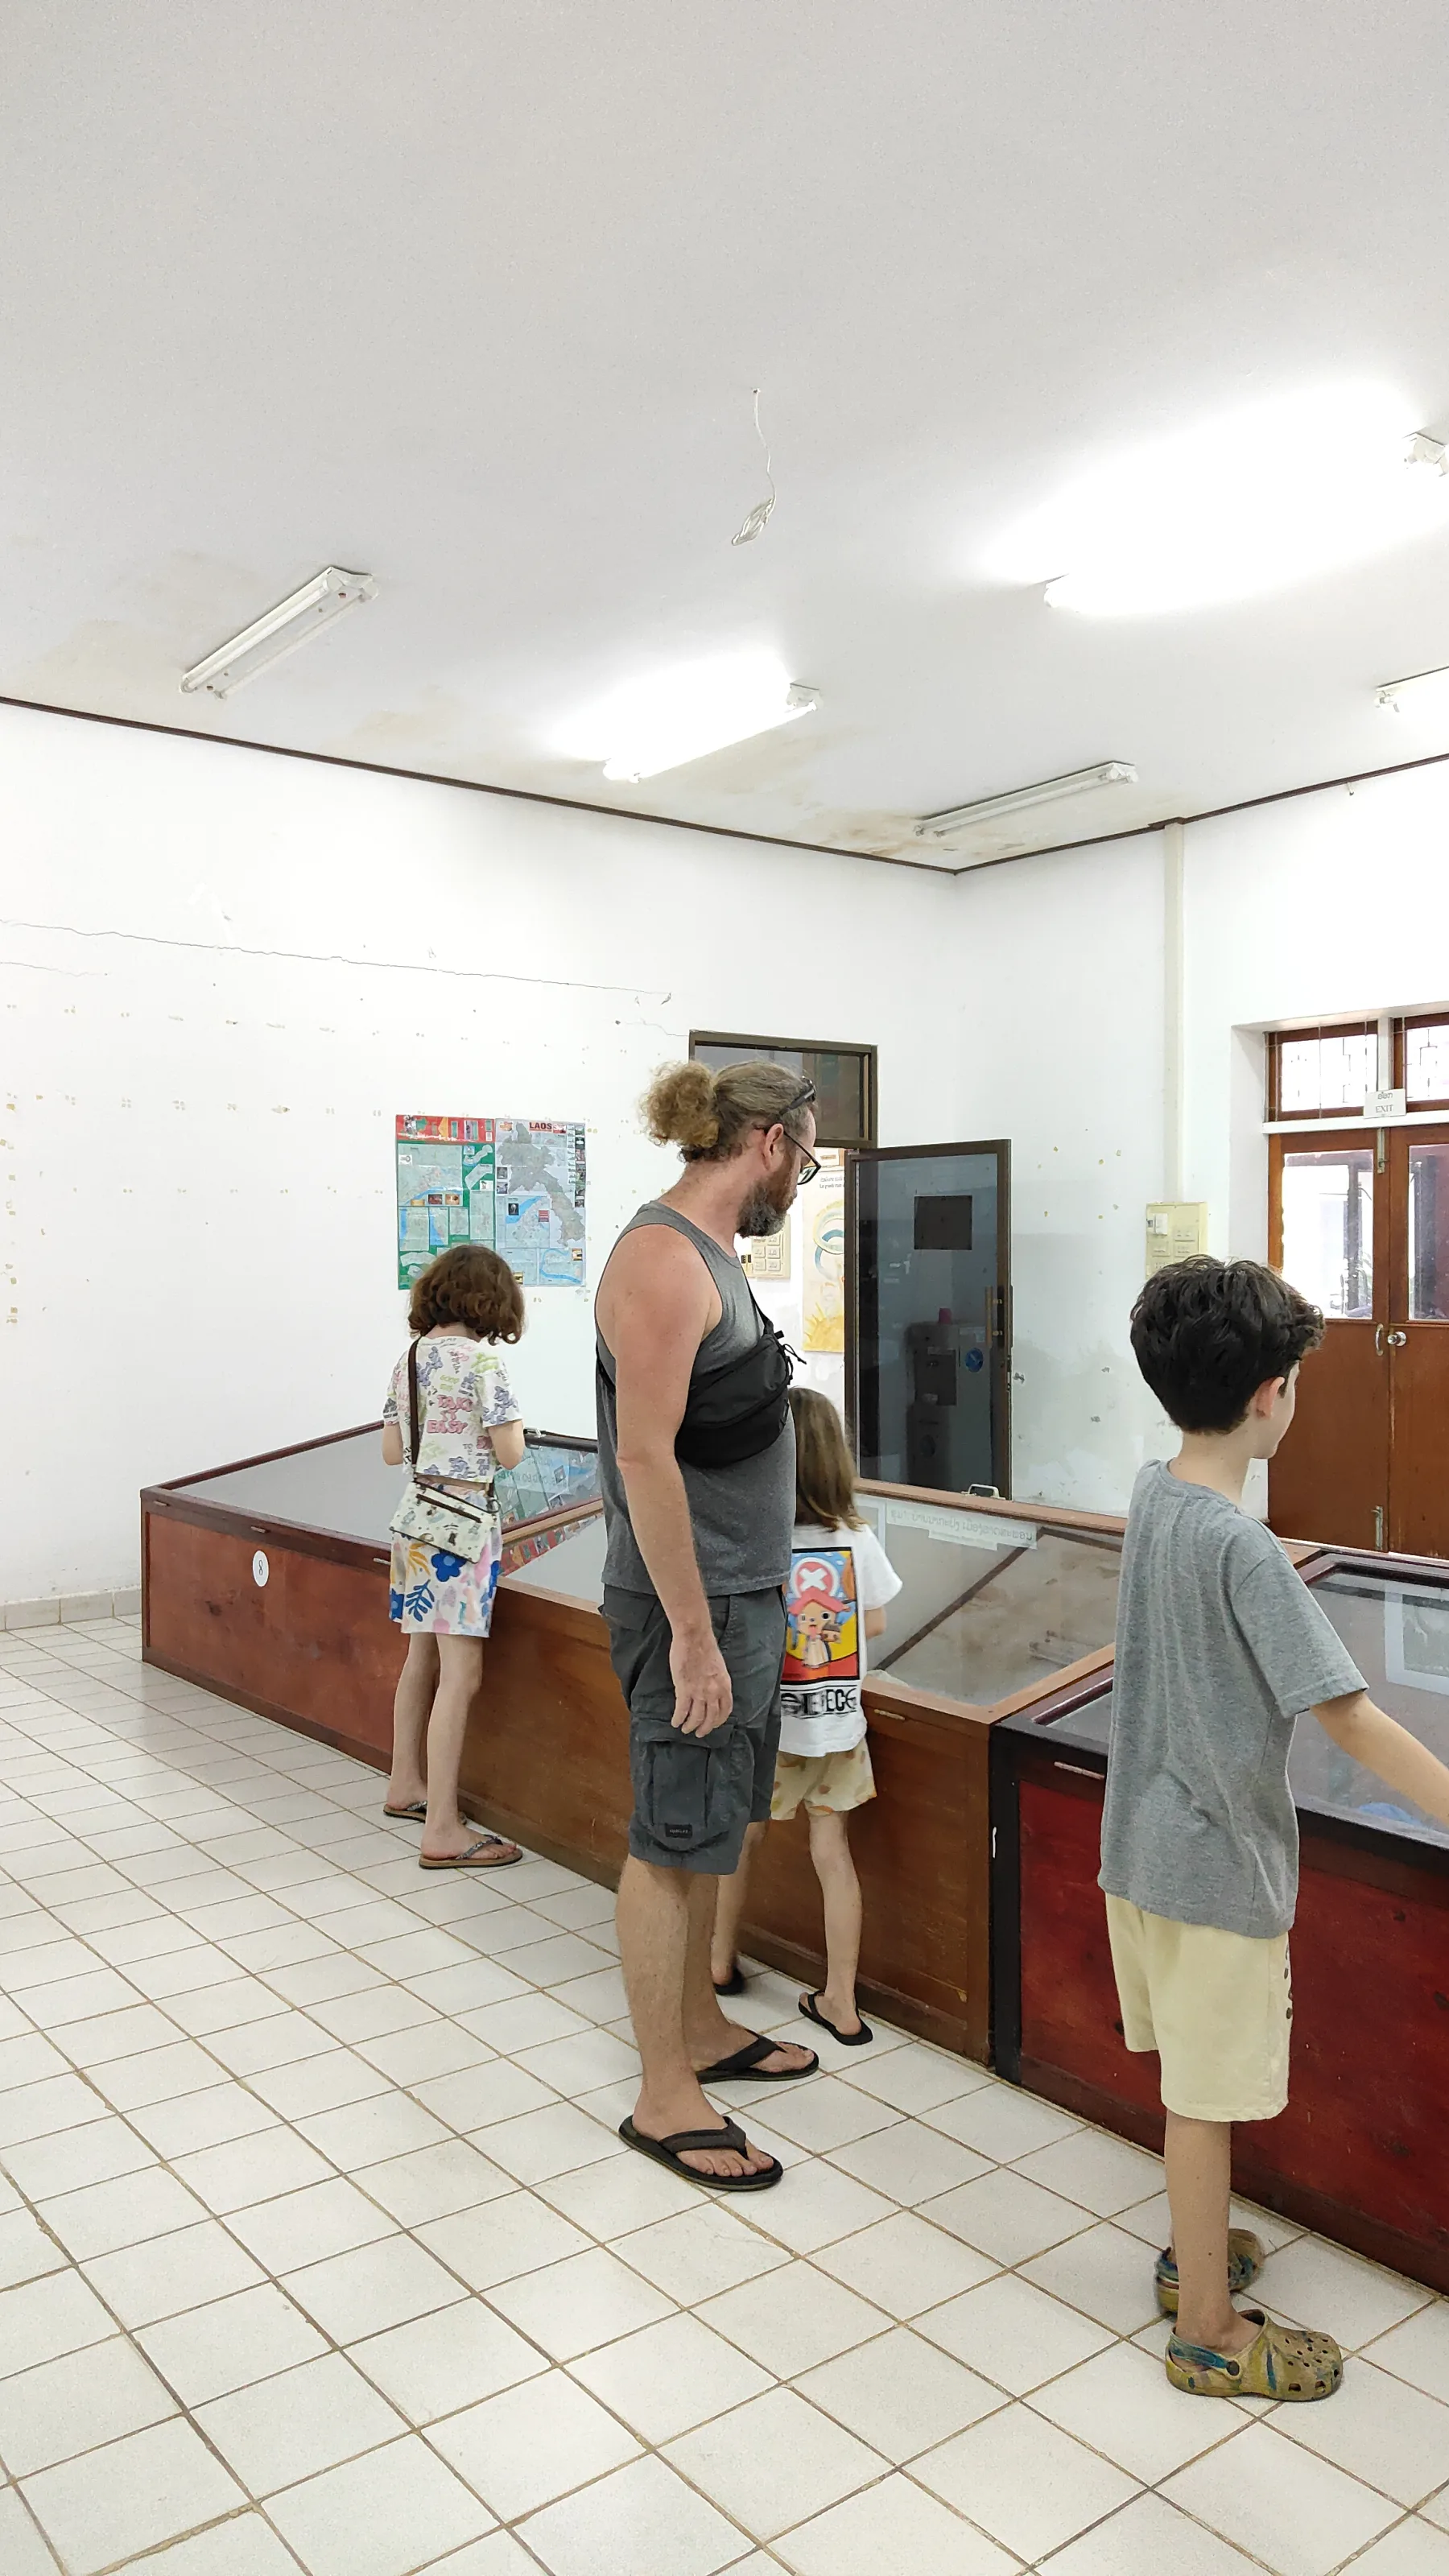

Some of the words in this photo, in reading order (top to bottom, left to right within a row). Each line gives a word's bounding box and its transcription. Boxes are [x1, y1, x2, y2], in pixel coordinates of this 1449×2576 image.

[1376, 1104, 1393, 1113] EXIT
[529, 1121, 552, 1130] LAOS
[427, 1419, 468, 1434] EASY
